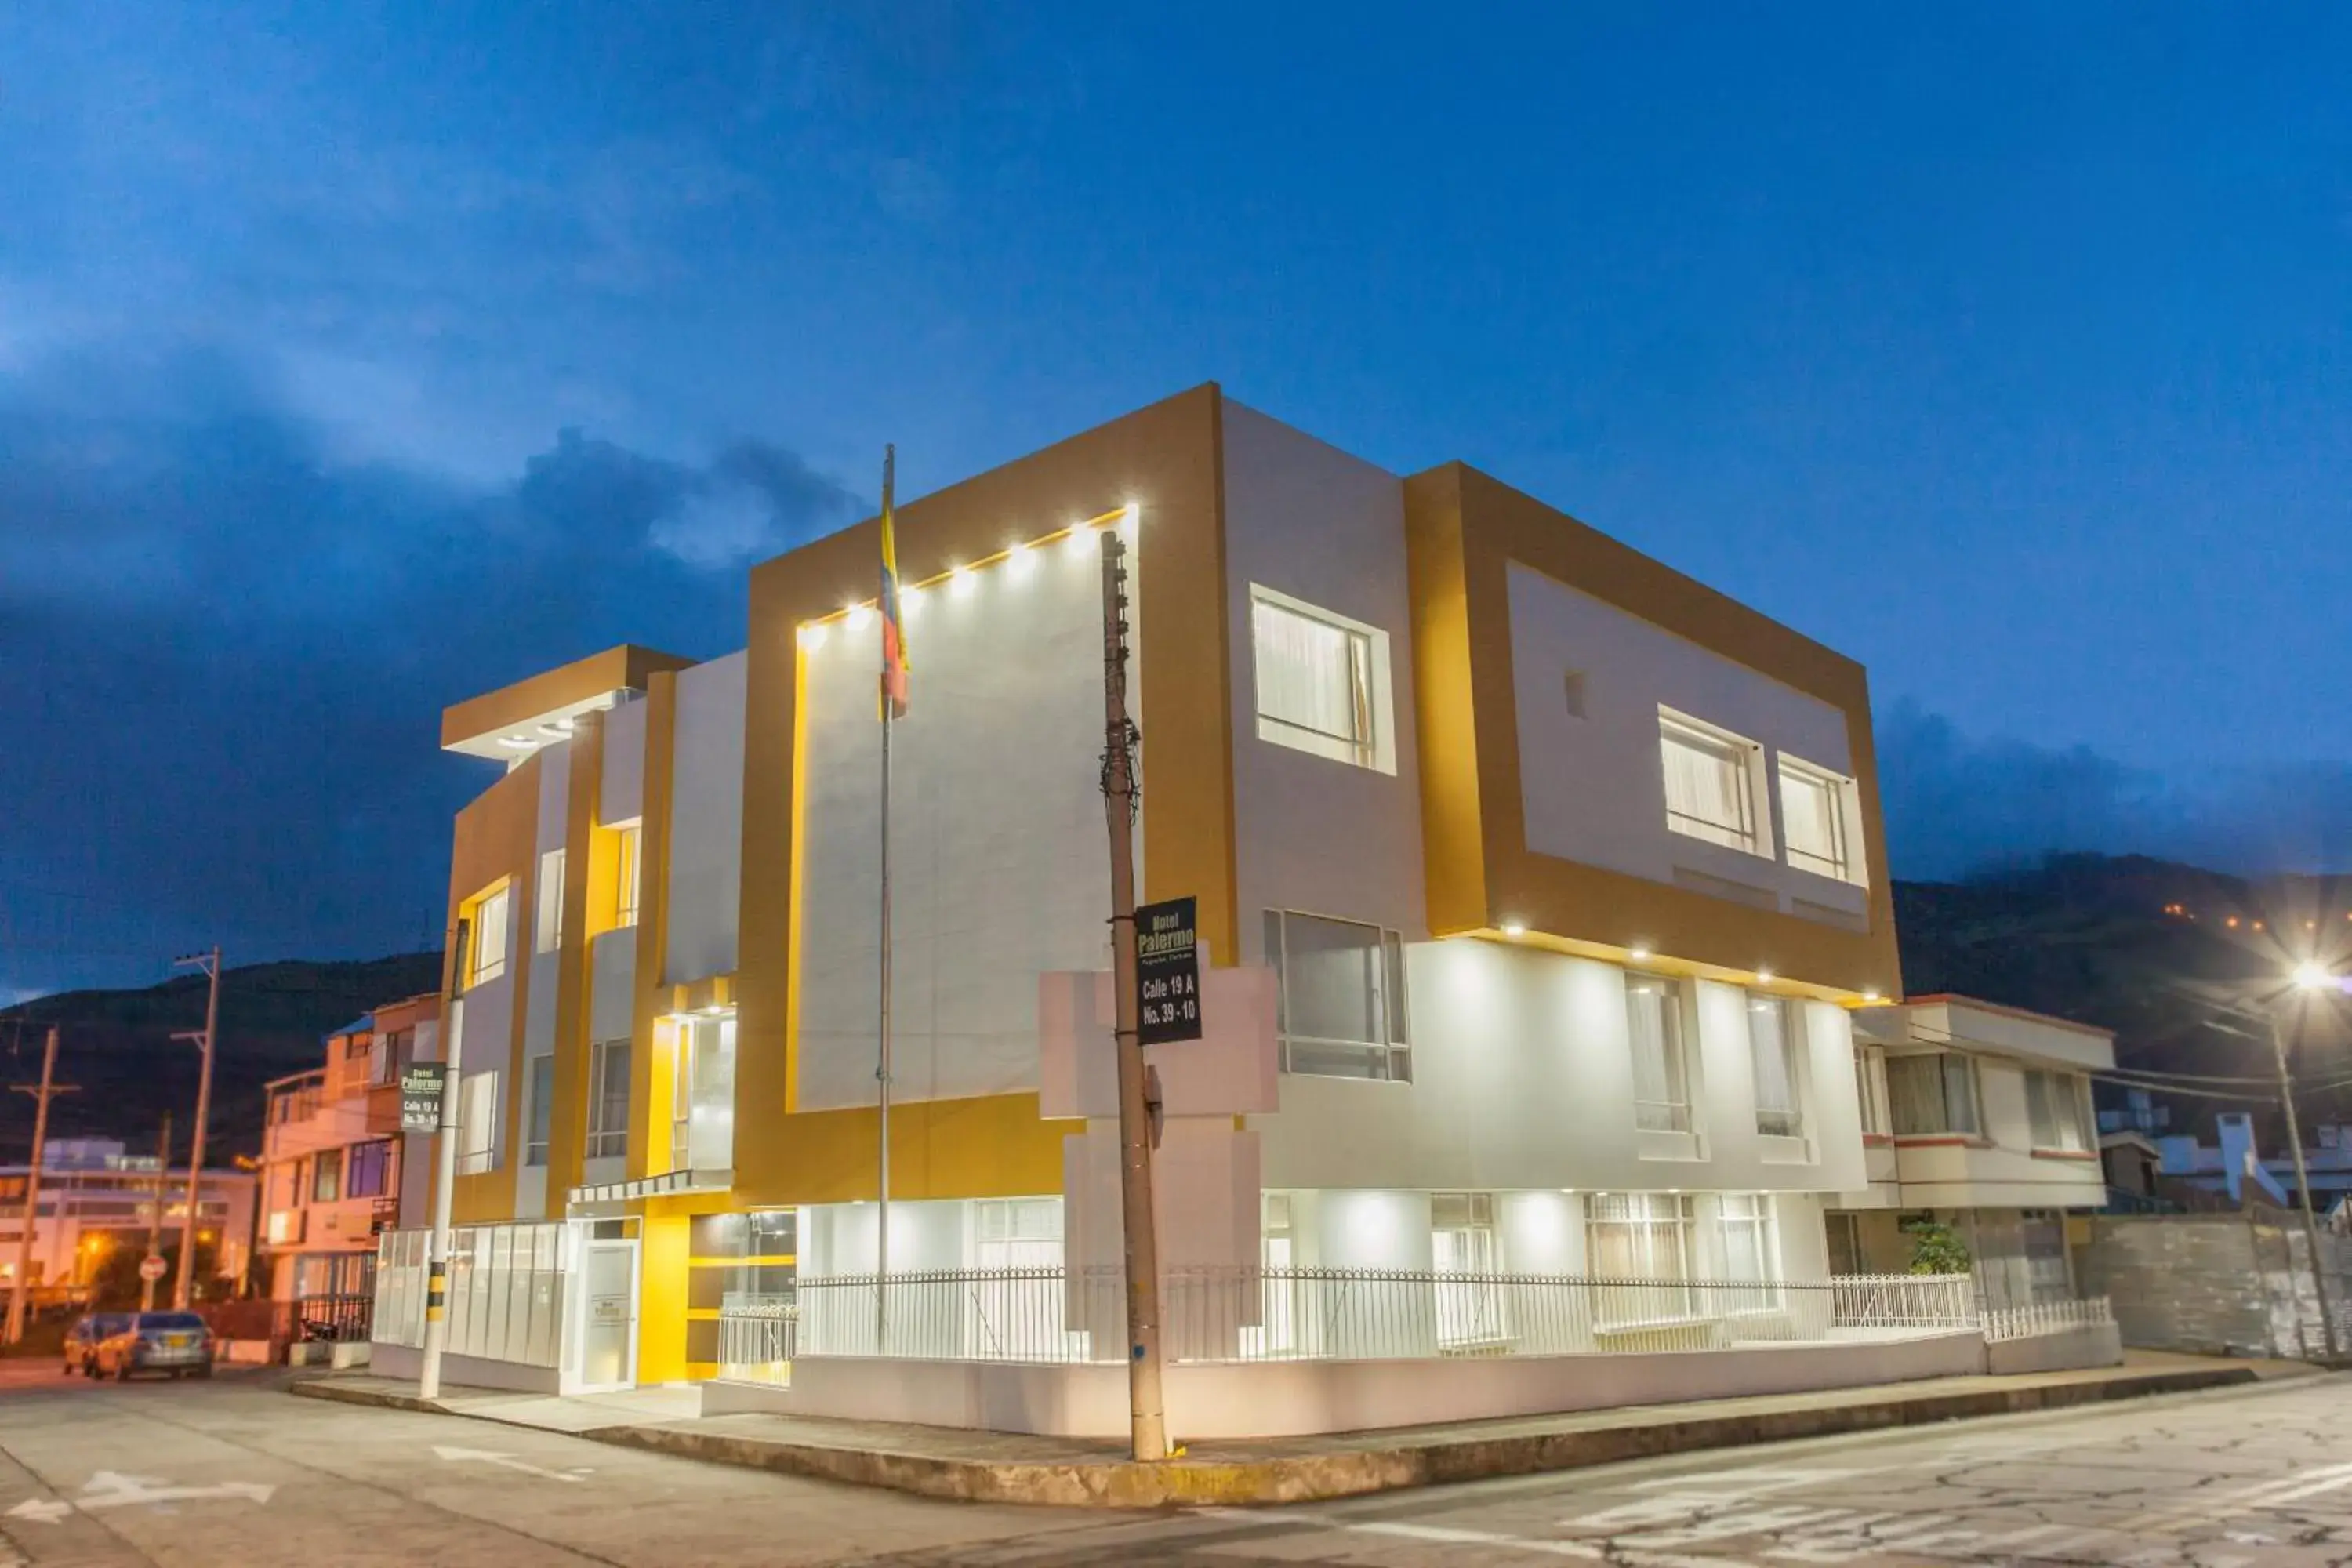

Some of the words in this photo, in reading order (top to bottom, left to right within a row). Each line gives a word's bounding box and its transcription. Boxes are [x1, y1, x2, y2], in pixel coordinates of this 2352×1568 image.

[1152, 912, 1178, 930] Hotel
[1139, 928, 1194, 953] Palermo
[1142, 979, 1167, 998] Calle
[1171, 975, 1182, 995] 19
[1185, 973, 1194, 994] A
[1143, 1006, 1160, 1025] No.
[1162, 1003, 1174, 1022] 39
[1182, 999, 1196, 1020] 10
[401, 1076, 443, 1089] Palermo
[404, 1101, 421, 1111] Calle
